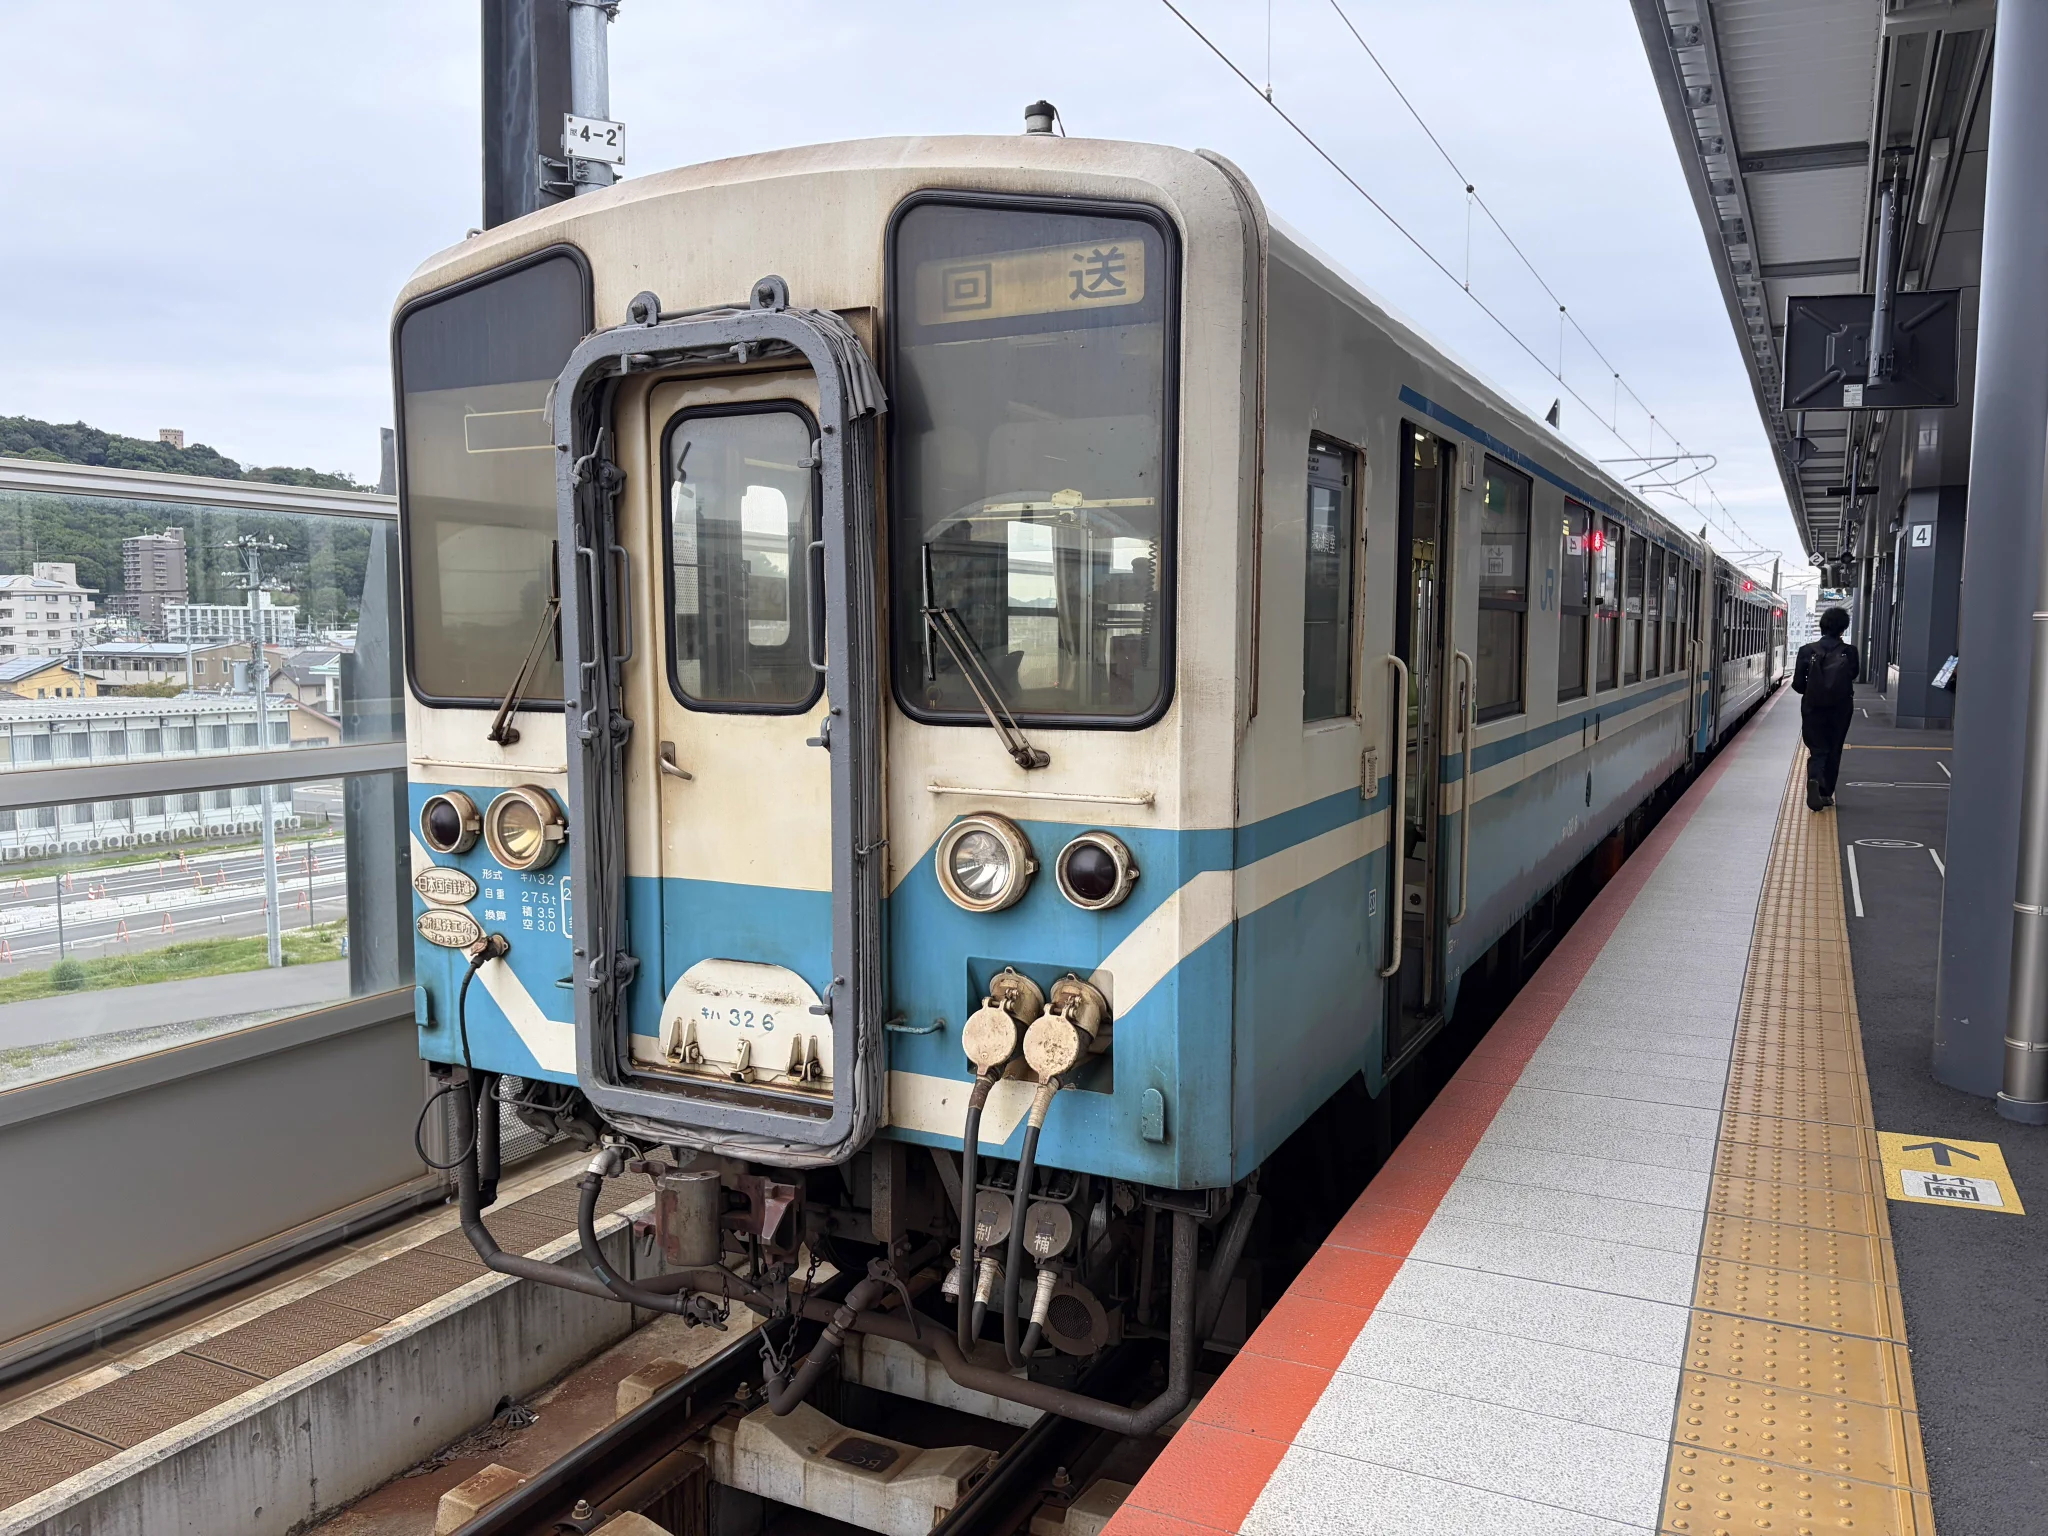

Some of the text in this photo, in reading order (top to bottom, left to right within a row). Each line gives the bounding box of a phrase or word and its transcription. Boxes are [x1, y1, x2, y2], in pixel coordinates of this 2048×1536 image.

[580, 125, 617, 147] 4-2
[943, 246, 1127, 313] 回送
[1916, 527, 1927, 544] 4
[1813, 555, 1820, 563] 2
[1540, 568, 1555, 611] JR
[482, 868, 503, 880] 形式
[418, 876, 471, 896] 日本国有鉄道
[485, 888, 505, 900] 自重
[485, 905, 555, 921] 換算 積 3.5
[522, 919, 533, 930] 空
[537, 920, 556, 932] 3.0
[975, 1222, 992, 1241] 制
[1034, 1235, 1052, 1253] 補
